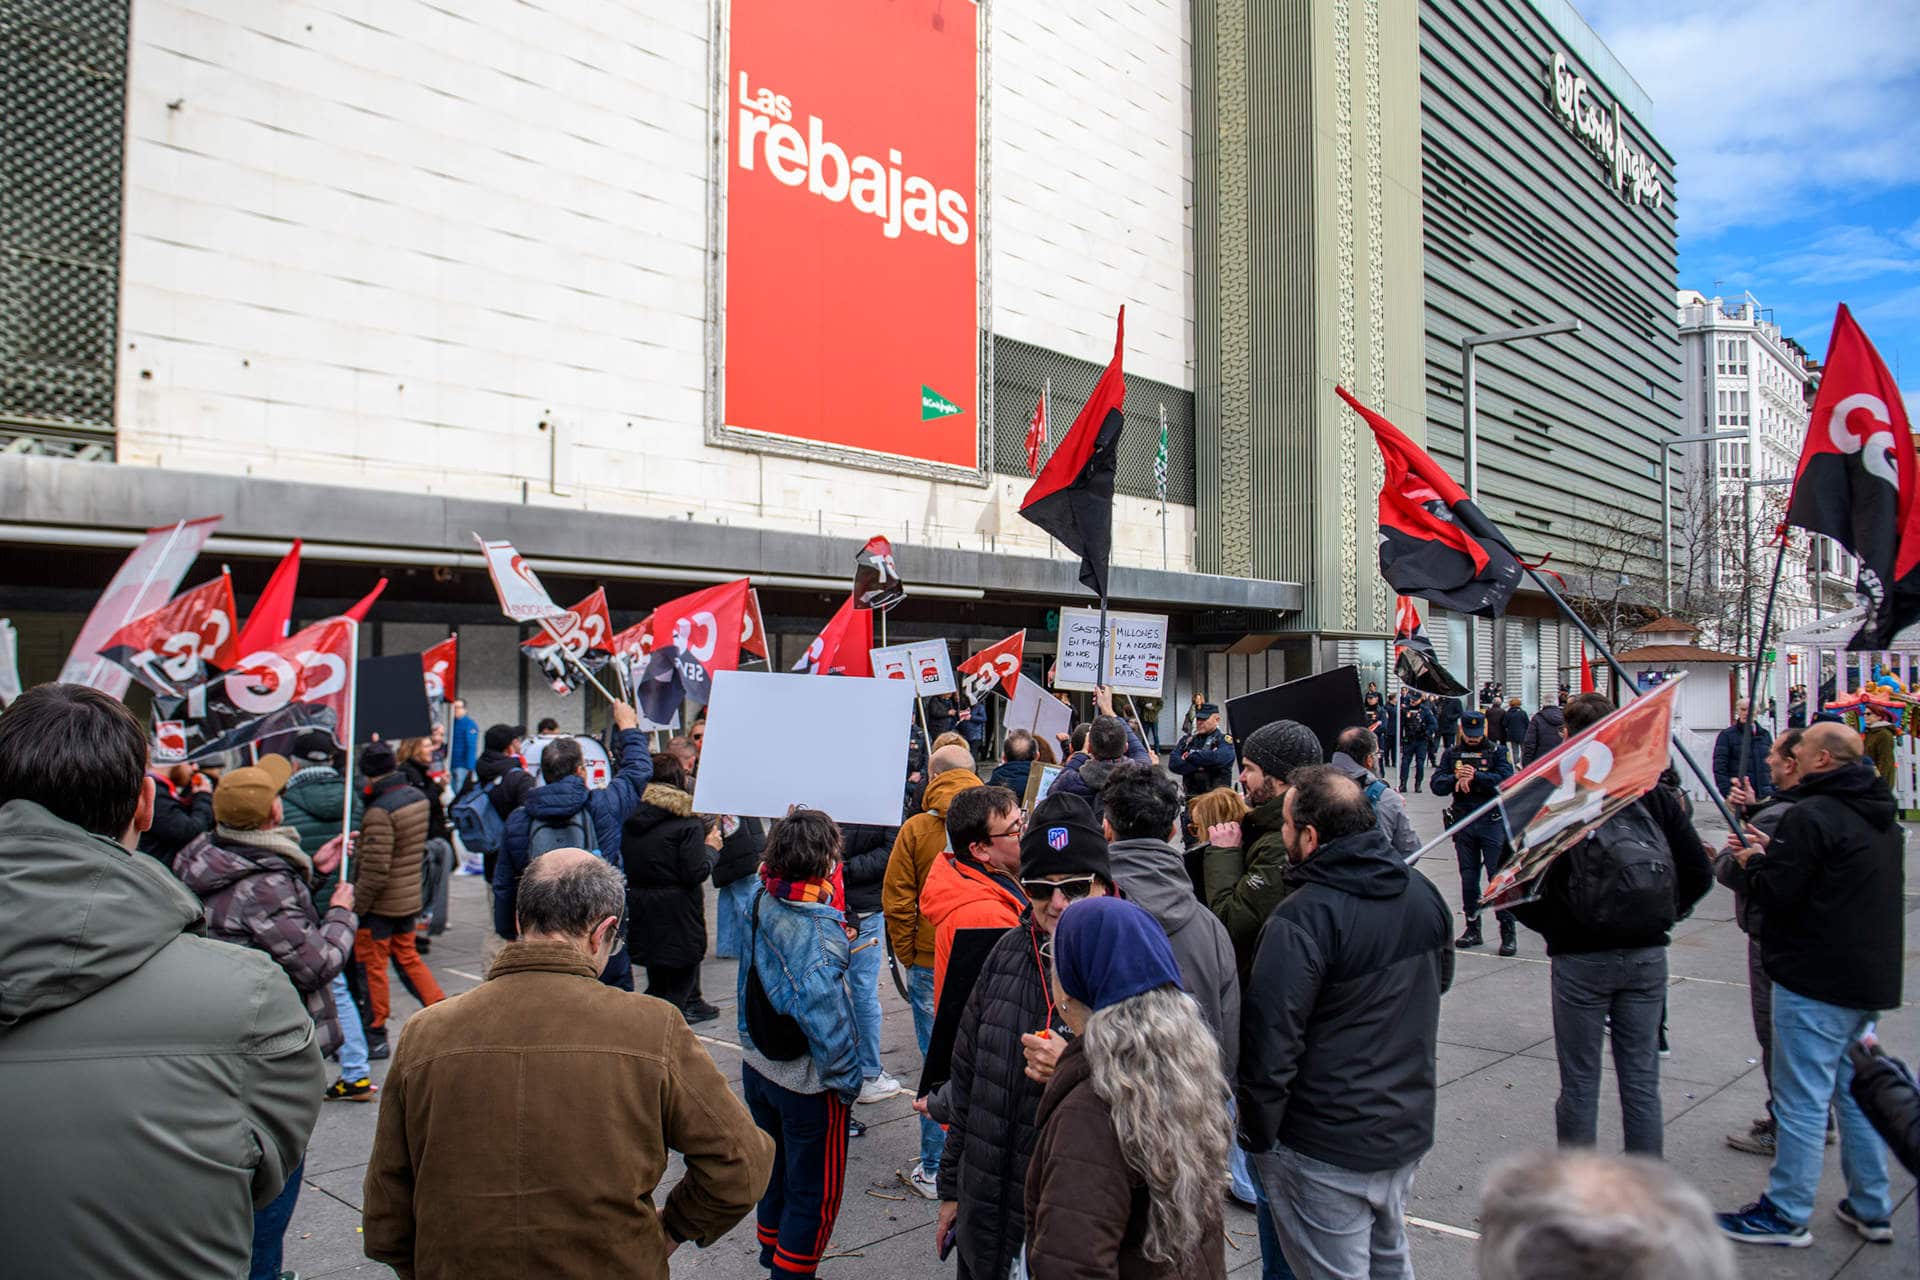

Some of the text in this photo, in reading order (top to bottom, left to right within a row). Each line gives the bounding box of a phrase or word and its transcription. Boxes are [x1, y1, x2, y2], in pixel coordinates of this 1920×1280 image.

[739, 70, 792, 122] Las
[738, 108, 969, 246] rebajas
[1116, 627, 1160, 639] MILLONES
[922, 674, 940, 684] CGT
